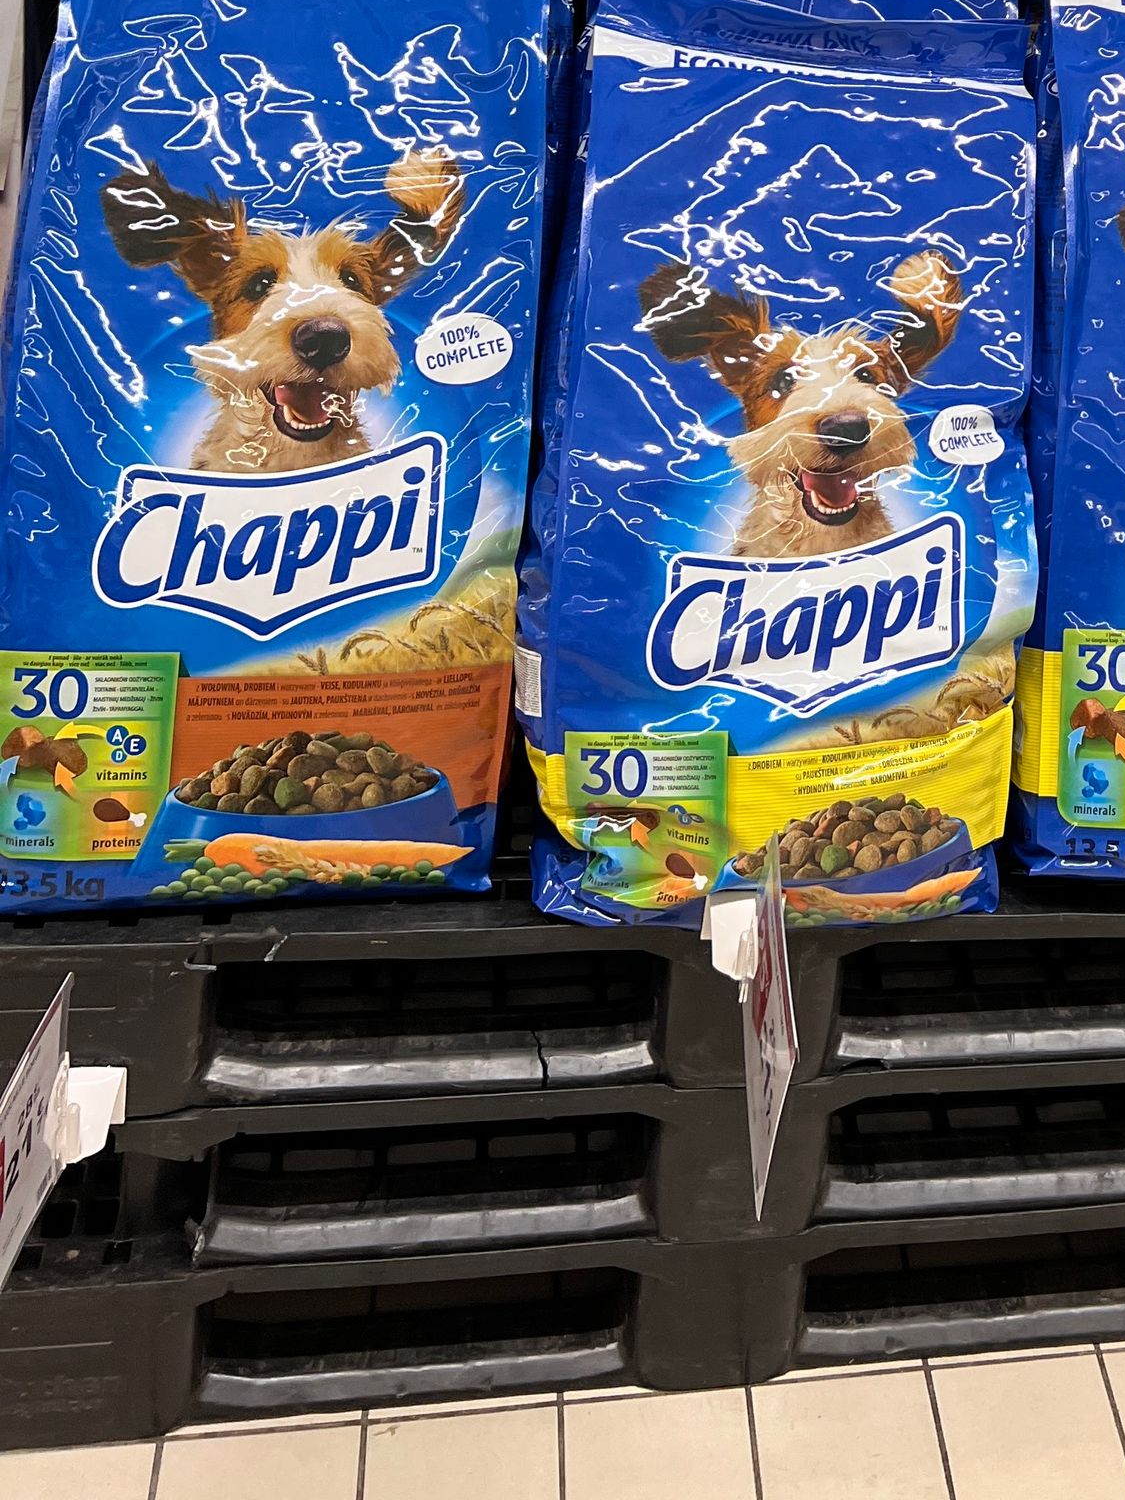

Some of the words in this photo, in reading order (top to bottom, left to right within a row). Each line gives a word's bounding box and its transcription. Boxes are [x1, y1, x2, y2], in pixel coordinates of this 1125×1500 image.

[440, 325, 480, 346] 100%
[426, 338, 508, 370] COMPLETE
[951, 416, 978, 431] 100%
[939, 432, 998, 453] COMPLETE
[98, 466, 427, 604] Chappi
[653, 546, 948, 683] Chappi
[11, 668, 89, 719] 30
[96, 768, 148, 782] vitamins
[580, 748, 648, 798] 30
[1074, 803, 1116, 817] minerals
[5, 835, 55, 849] minerals
[92, 835, 141, 852] proteins
[667, 826, 710, 847] vitamins
[65, 870, 105, 902] kg
